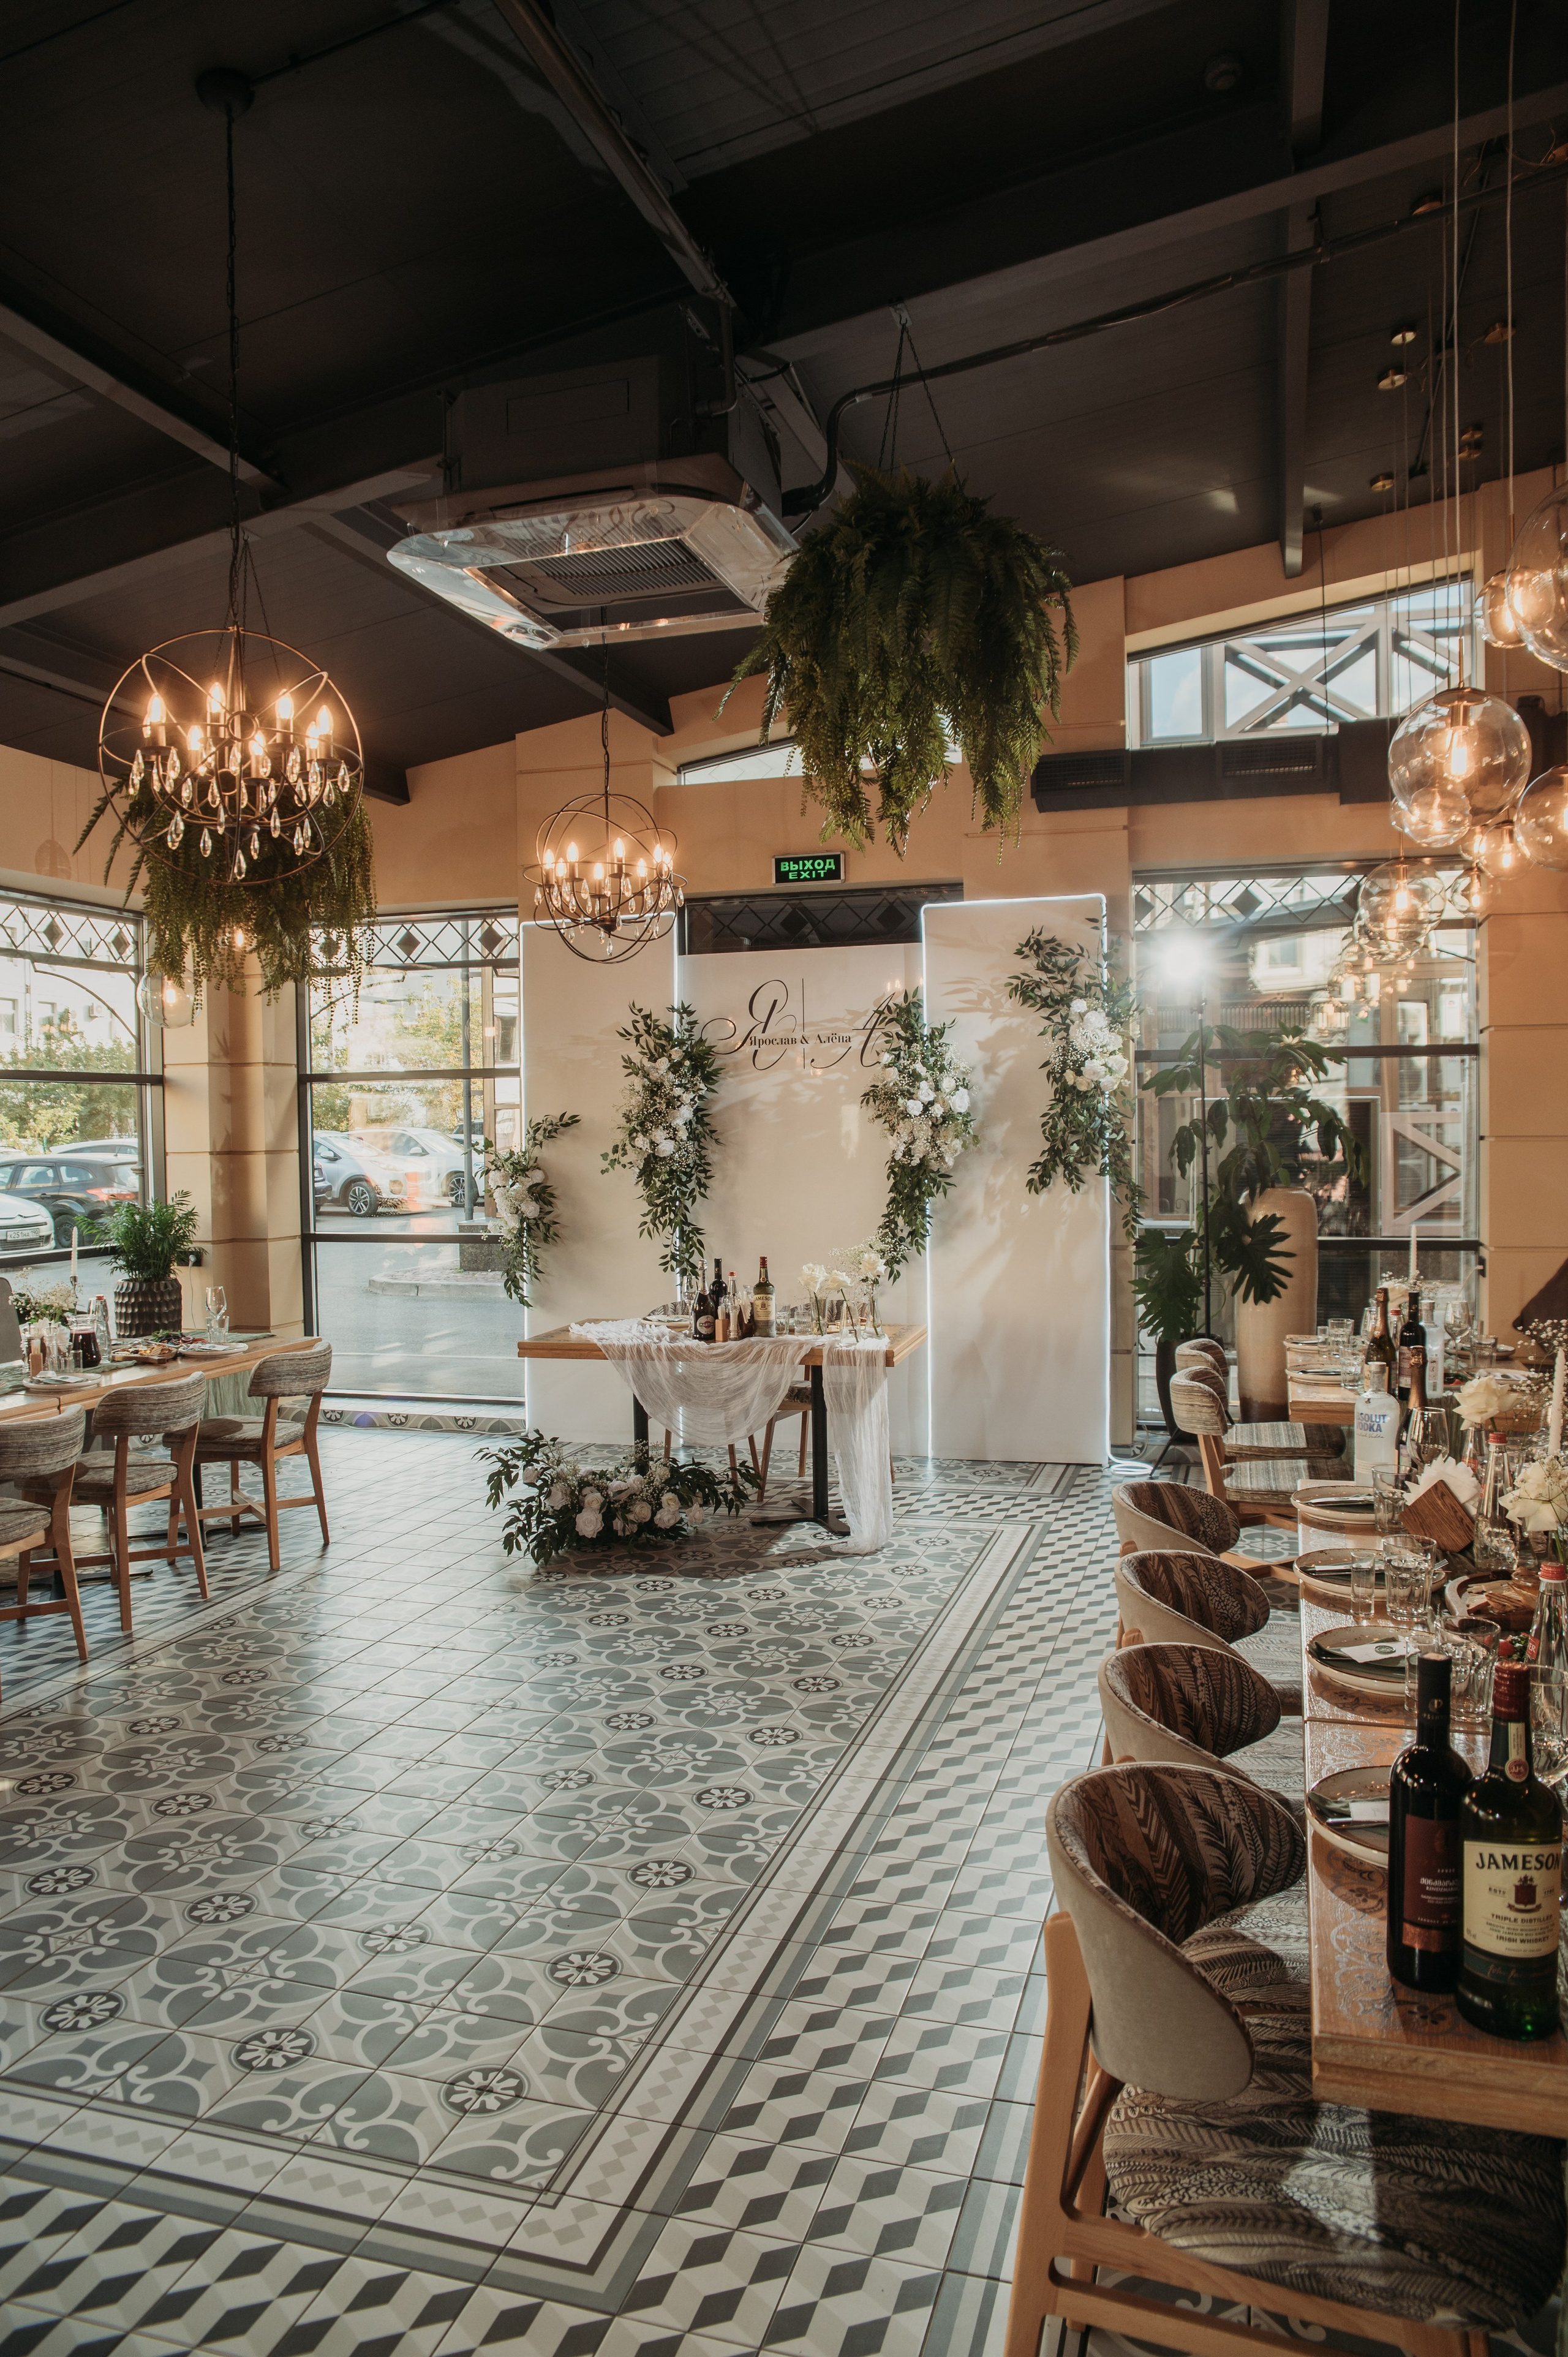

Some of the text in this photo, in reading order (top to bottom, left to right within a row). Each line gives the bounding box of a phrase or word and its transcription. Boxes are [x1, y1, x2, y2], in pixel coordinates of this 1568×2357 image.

[780, 859, 835, 872] ВЫХОД
[789, 870, 827, 879] EXIT
[748, 1033, 852, 1048] Ярослав & Алёна
[1476, 1852, 1561, 1871] JAMESON
[1491, 1914, 1553, 1924] TRIPLE DISTILLED
[1496, 1934, 1518, 1944] IRISH
